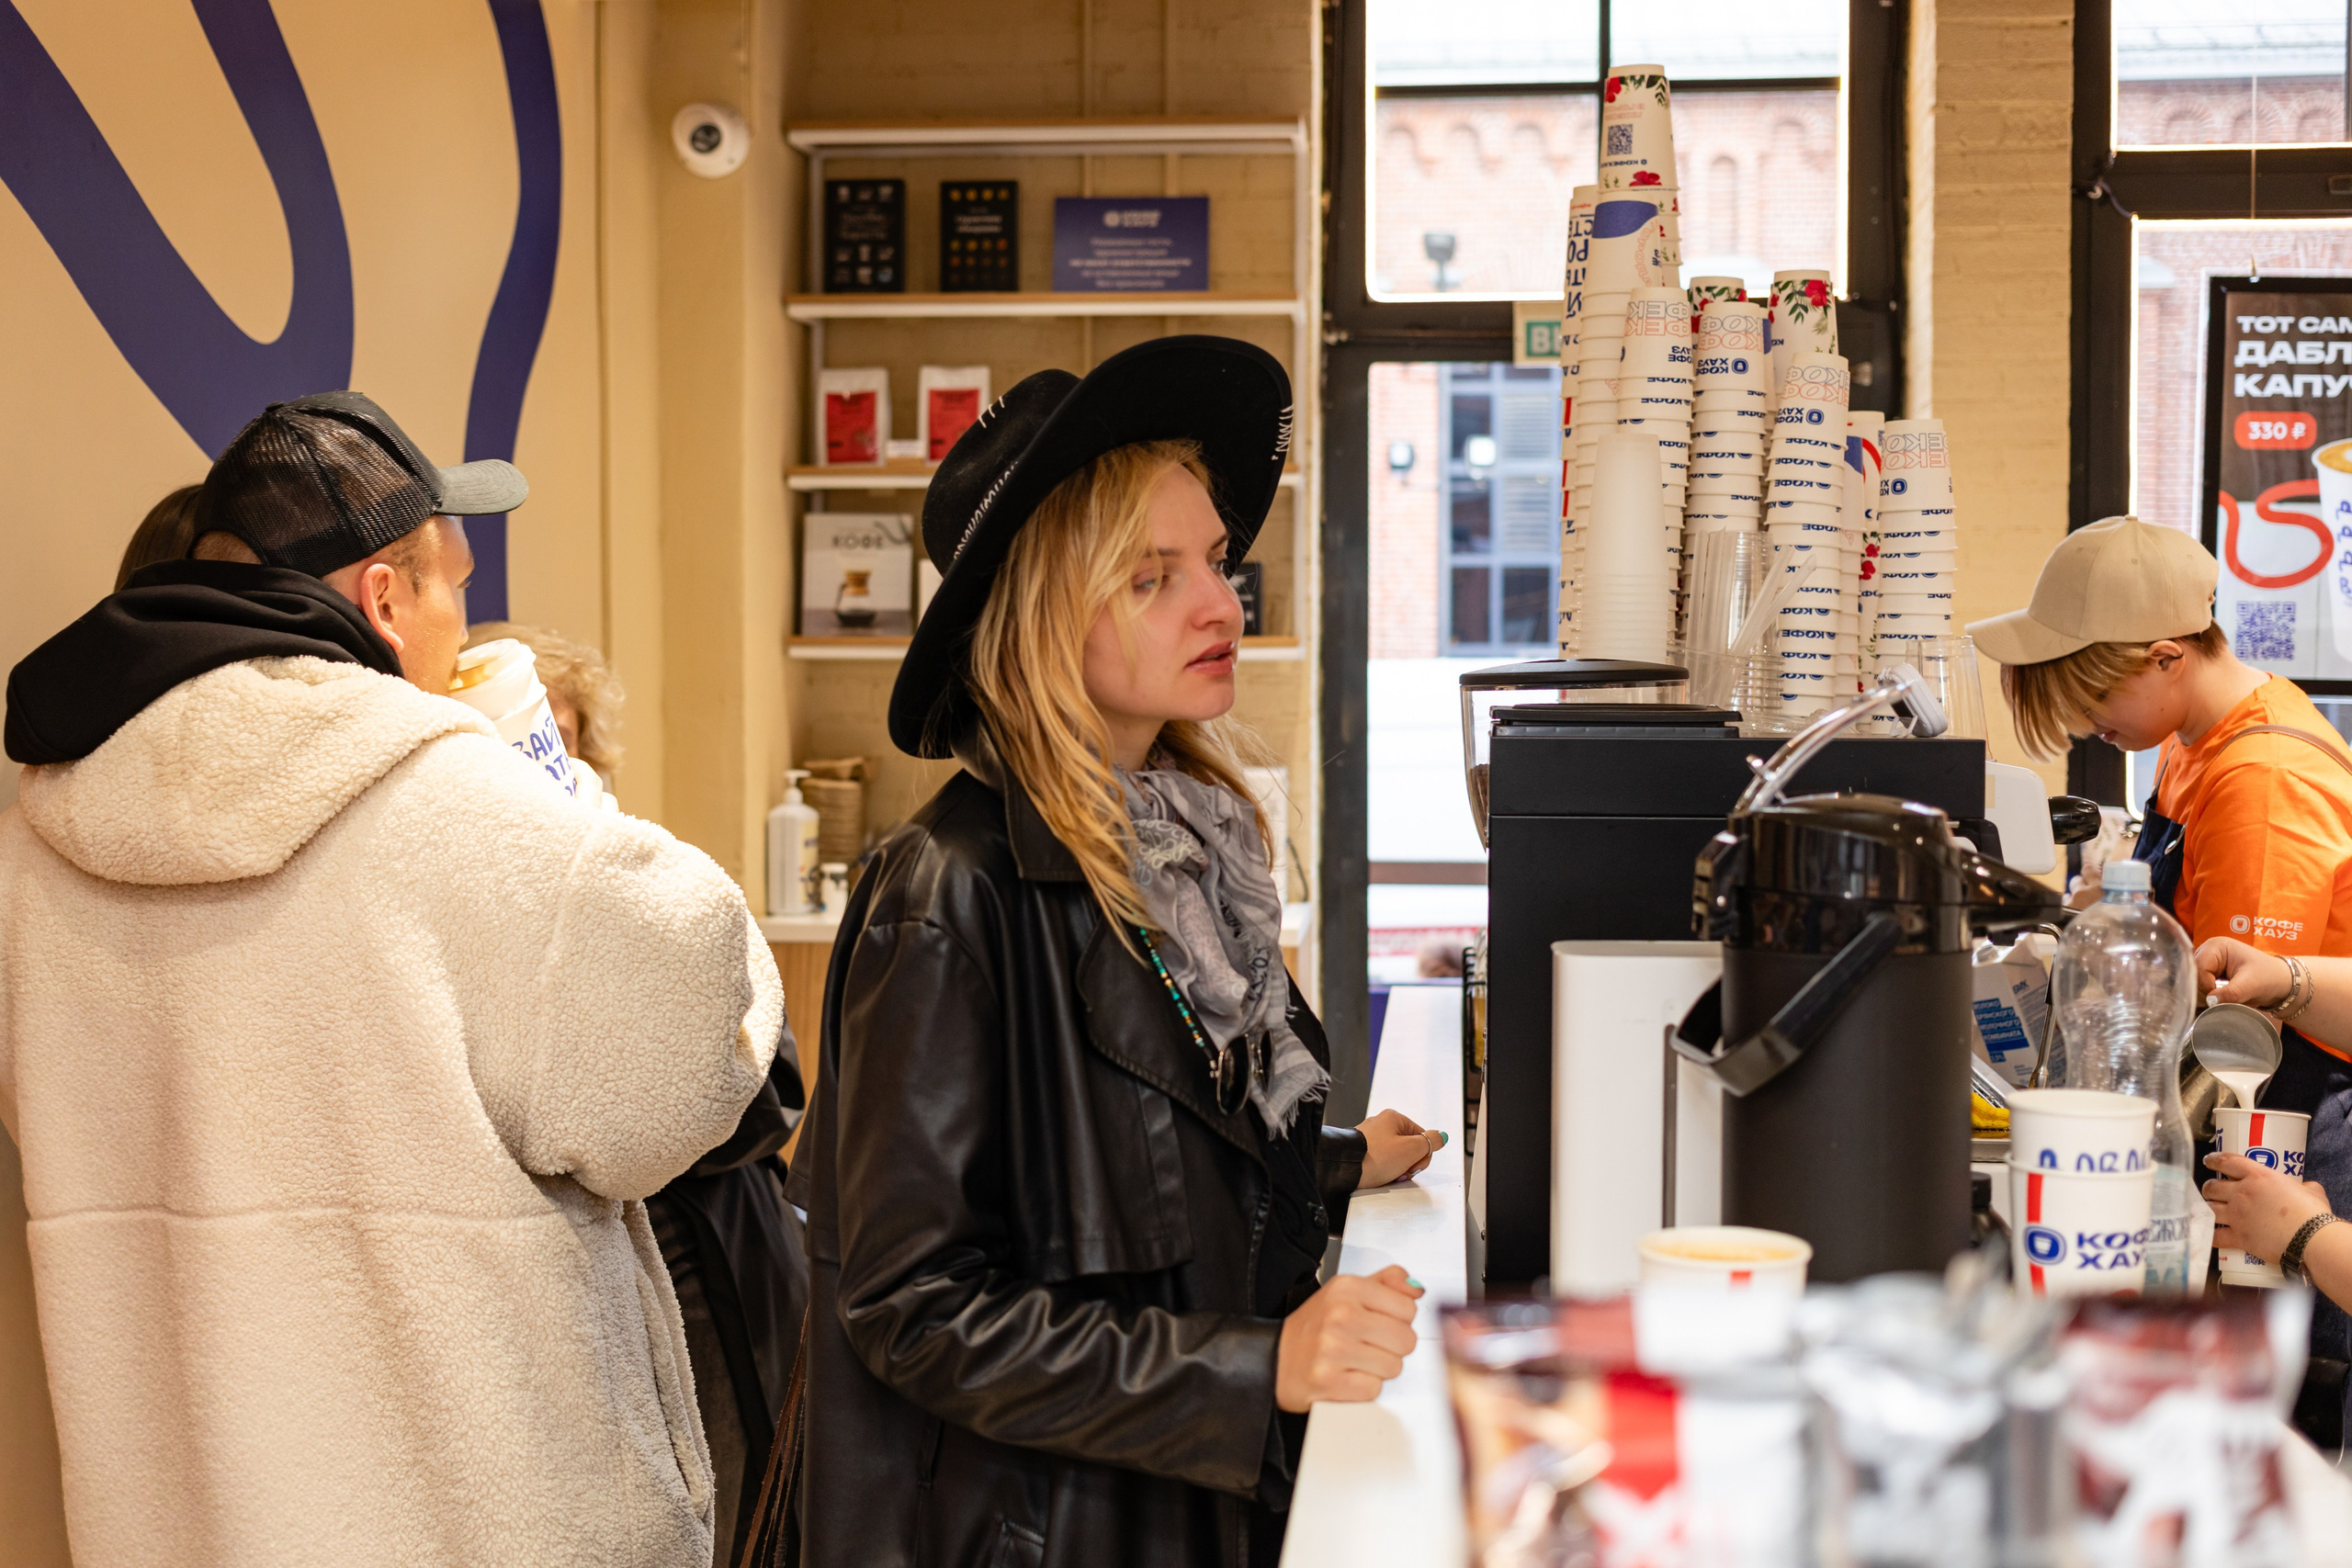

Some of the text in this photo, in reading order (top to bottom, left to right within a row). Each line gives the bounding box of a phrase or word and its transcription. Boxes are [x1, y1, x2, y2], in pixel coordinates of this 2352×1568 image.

[2236, 315, 2295, 333] ТОТ
[1671, 346, 1692, 355] АУЗ
[2233, 341, 2352, 367] ДАБЛ
[1668, 354, 1693, 363] ОФЕ
[2234, 373, 2352, 398] КАПУ
[2248, 422, 2288, 440] 330
[1782, 629, 1825, 638] КОФЕ
[2253, 916, 2304, 931] КОФЕ
[2253, 926, 2298, 941] ХАУЗ
